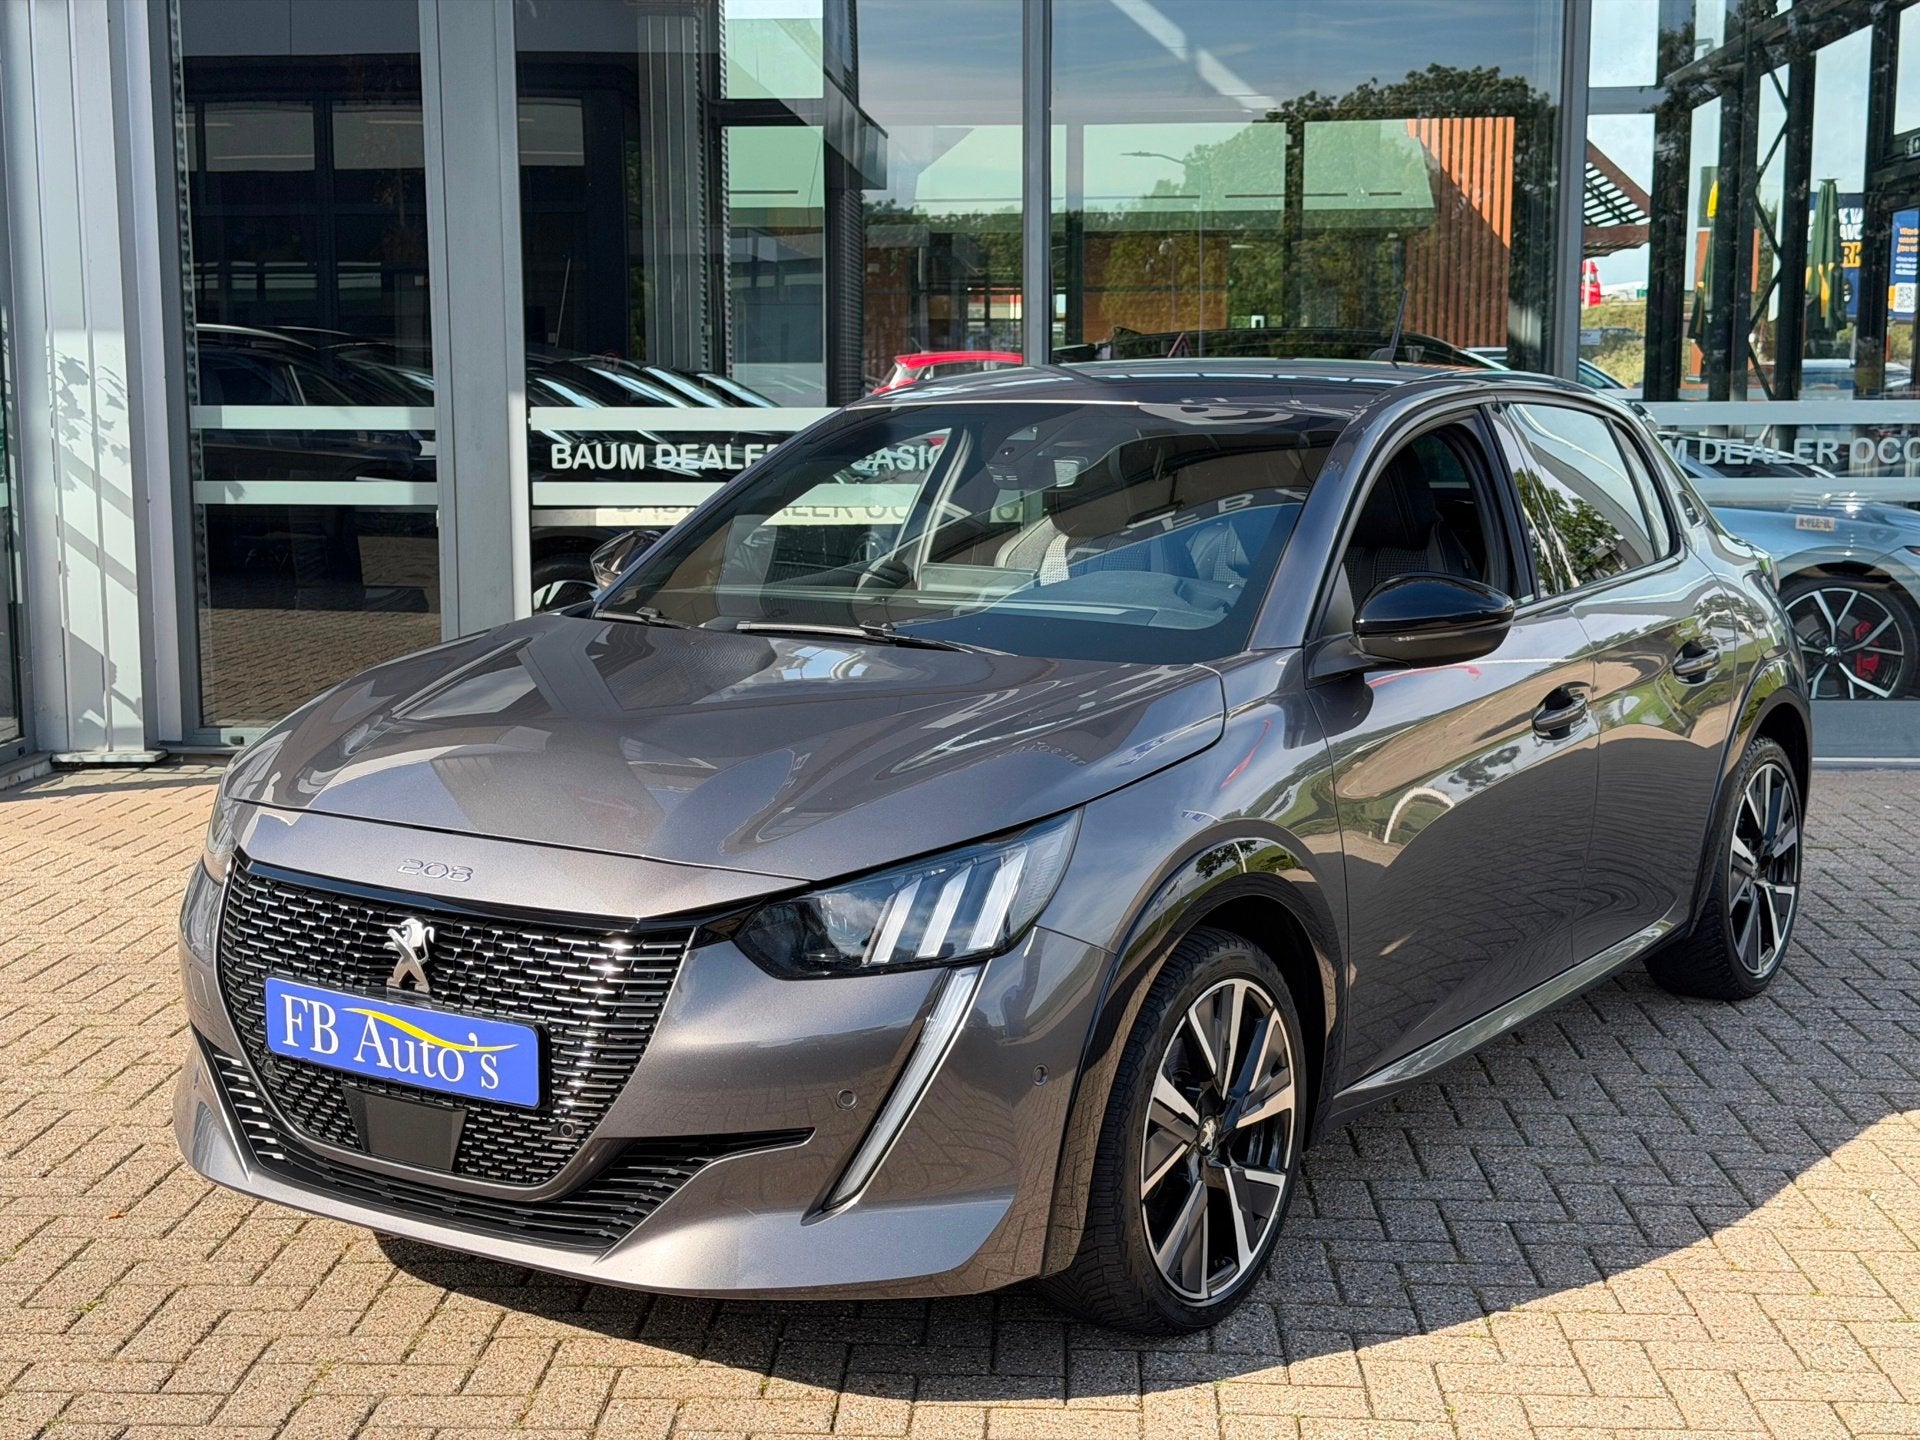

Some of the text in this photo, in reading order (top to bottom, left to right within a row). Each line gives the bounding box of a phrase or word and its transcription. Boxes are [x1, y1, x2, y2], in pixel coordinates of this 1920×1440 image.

[551, 444, 645, 470] BAUM
[655, 444, 779, 470] DEALE
[1699, 438, 1839, 465] DEALER
[397, 858, 474, 883] 208
[280, 993, 499, 1090] FB Auto's
